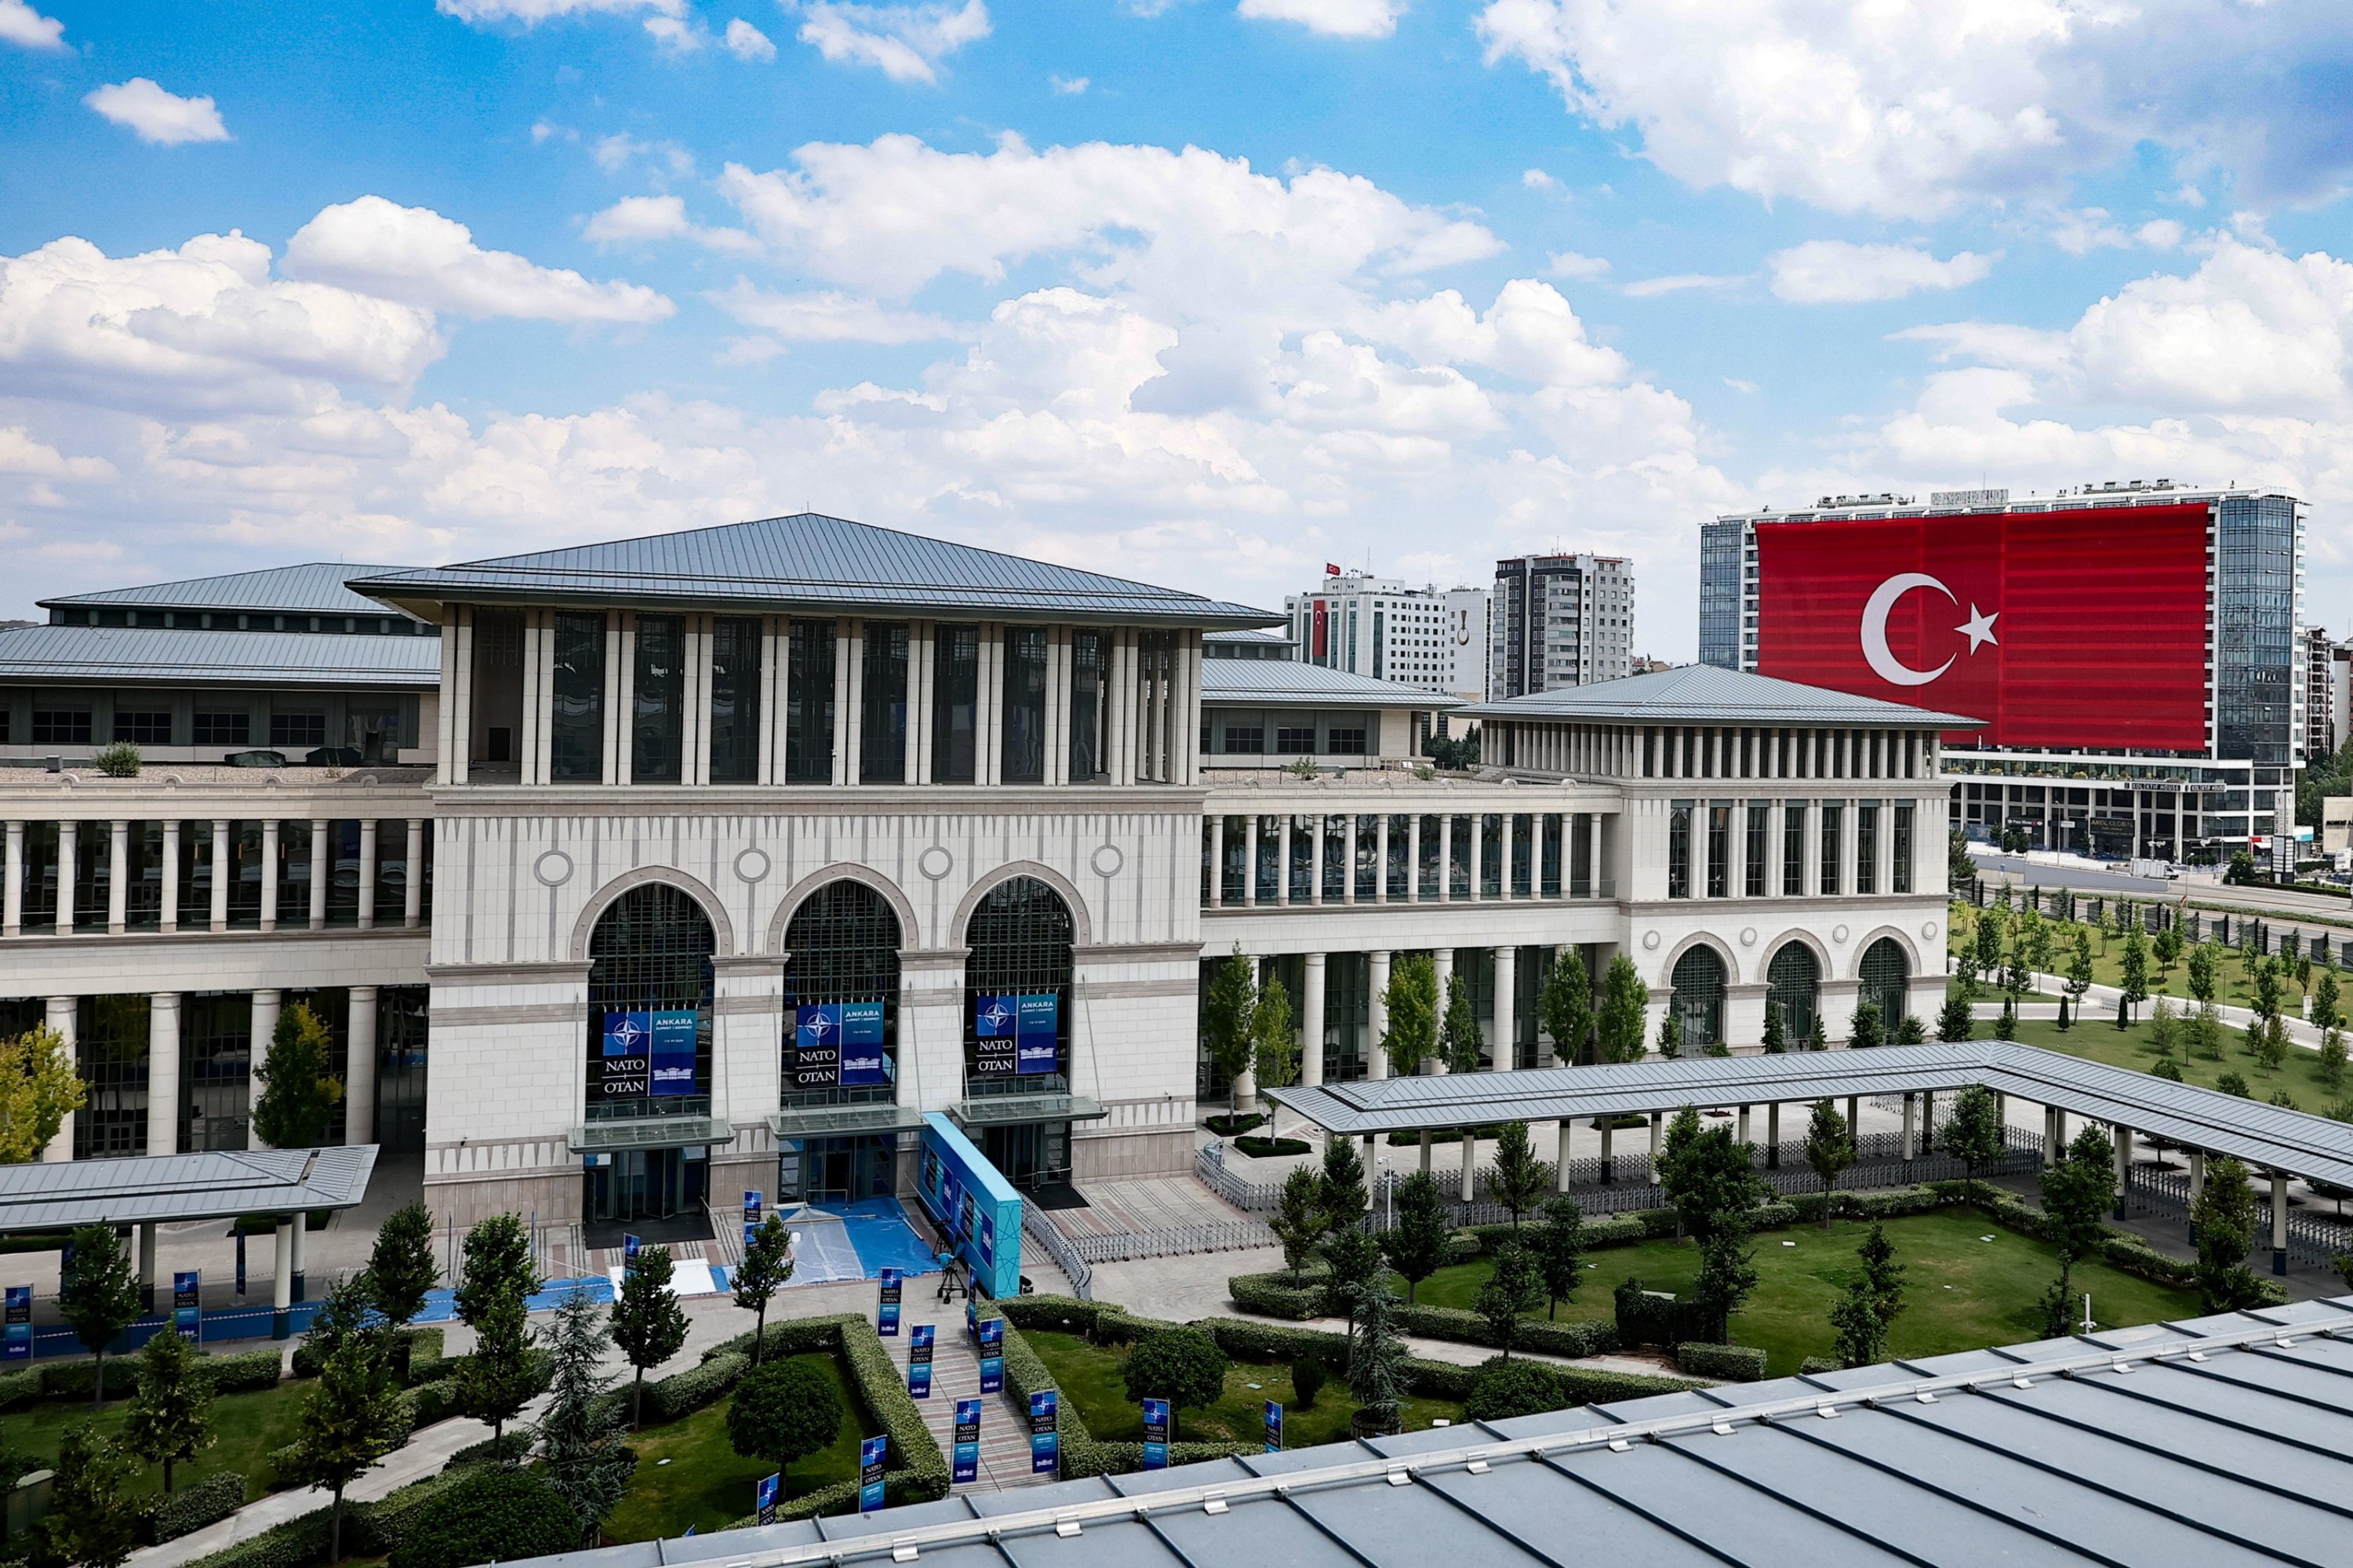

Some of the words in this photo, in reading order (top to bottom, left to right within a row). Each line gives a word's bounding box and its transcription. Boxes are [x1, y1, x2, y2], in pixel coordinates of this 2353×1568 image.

[979, 1039, 1013, 1051] NATO
[799, 1050, 836, 1062] NATO
[606, 1059, 646, 1072] NATO
[978, 1060, 1013, 1071] OTAN
[798, 1070, 835, 1083] OTAN
[604, 1080, 645, 1093] OTAN
[866, 1464, 882, 1474] NATO
[865, 1474, 882, 1484] OTAN
